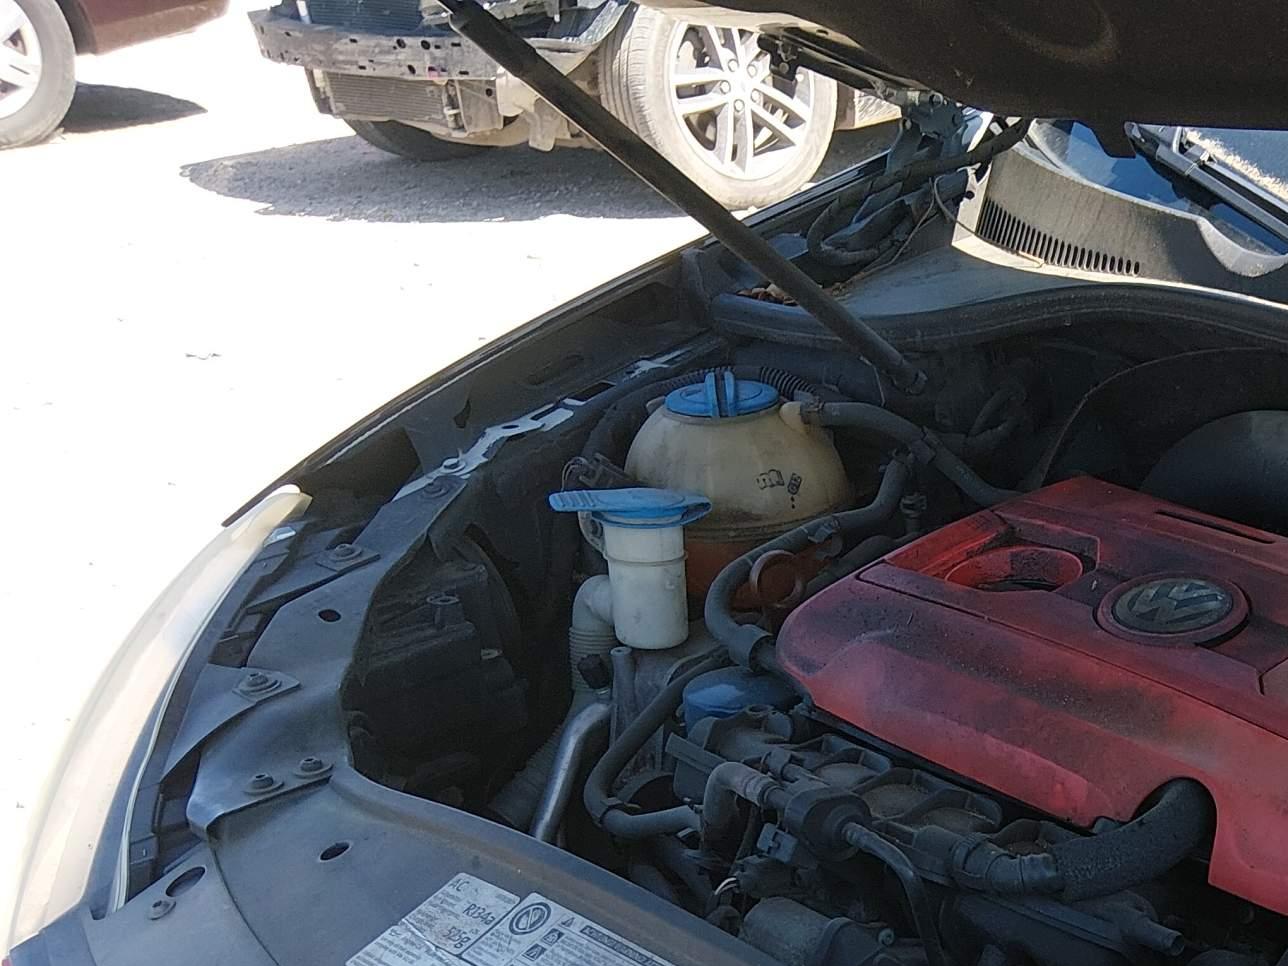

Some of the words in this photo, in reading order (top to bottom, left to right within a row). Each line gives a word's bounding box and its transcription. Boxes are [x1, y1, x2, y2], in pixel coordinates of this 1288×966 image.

[448, 879, 469, 892] AC
[463, 904, 496, 925] R134a
[443, 927, 471, 948] 525g
